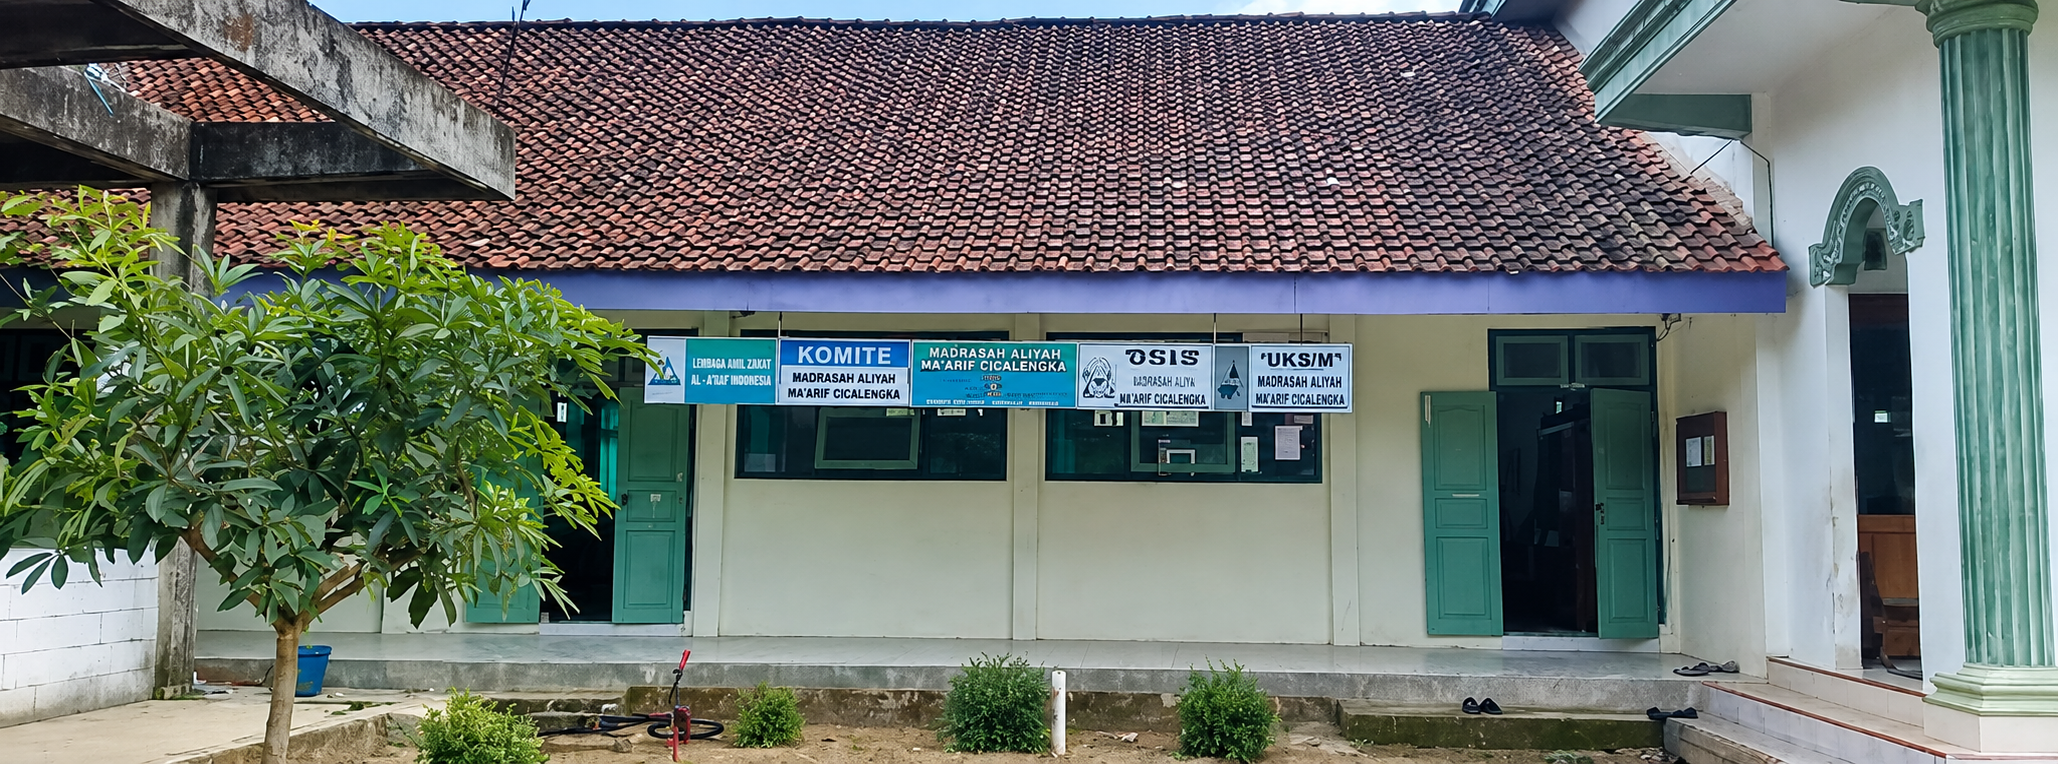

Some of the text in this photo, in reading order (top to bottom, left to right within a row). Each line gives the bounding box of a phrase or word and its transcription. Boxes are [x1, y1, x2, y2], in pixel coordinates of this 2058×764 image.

[797, 346, 891, 364] KOMITE
[929, 347, 1061, 360] MADRASAH ALIYAH
[921, 360, 1067, 372] MA'ARIF CICALENGKA
[730, 375, 772, 386] INDONESIA
[792, 372, 896, 384] MADRASAH ALIYAH
[1257, 375, 1342, 388] MADRASAH ALIYAH
[787, 387, 900, 399] MA'ARIF CICALENGKA
[1154, 393, 1206, 405] CICALENGKA
[1291, 393, 1345, 405] CICALENGKA
